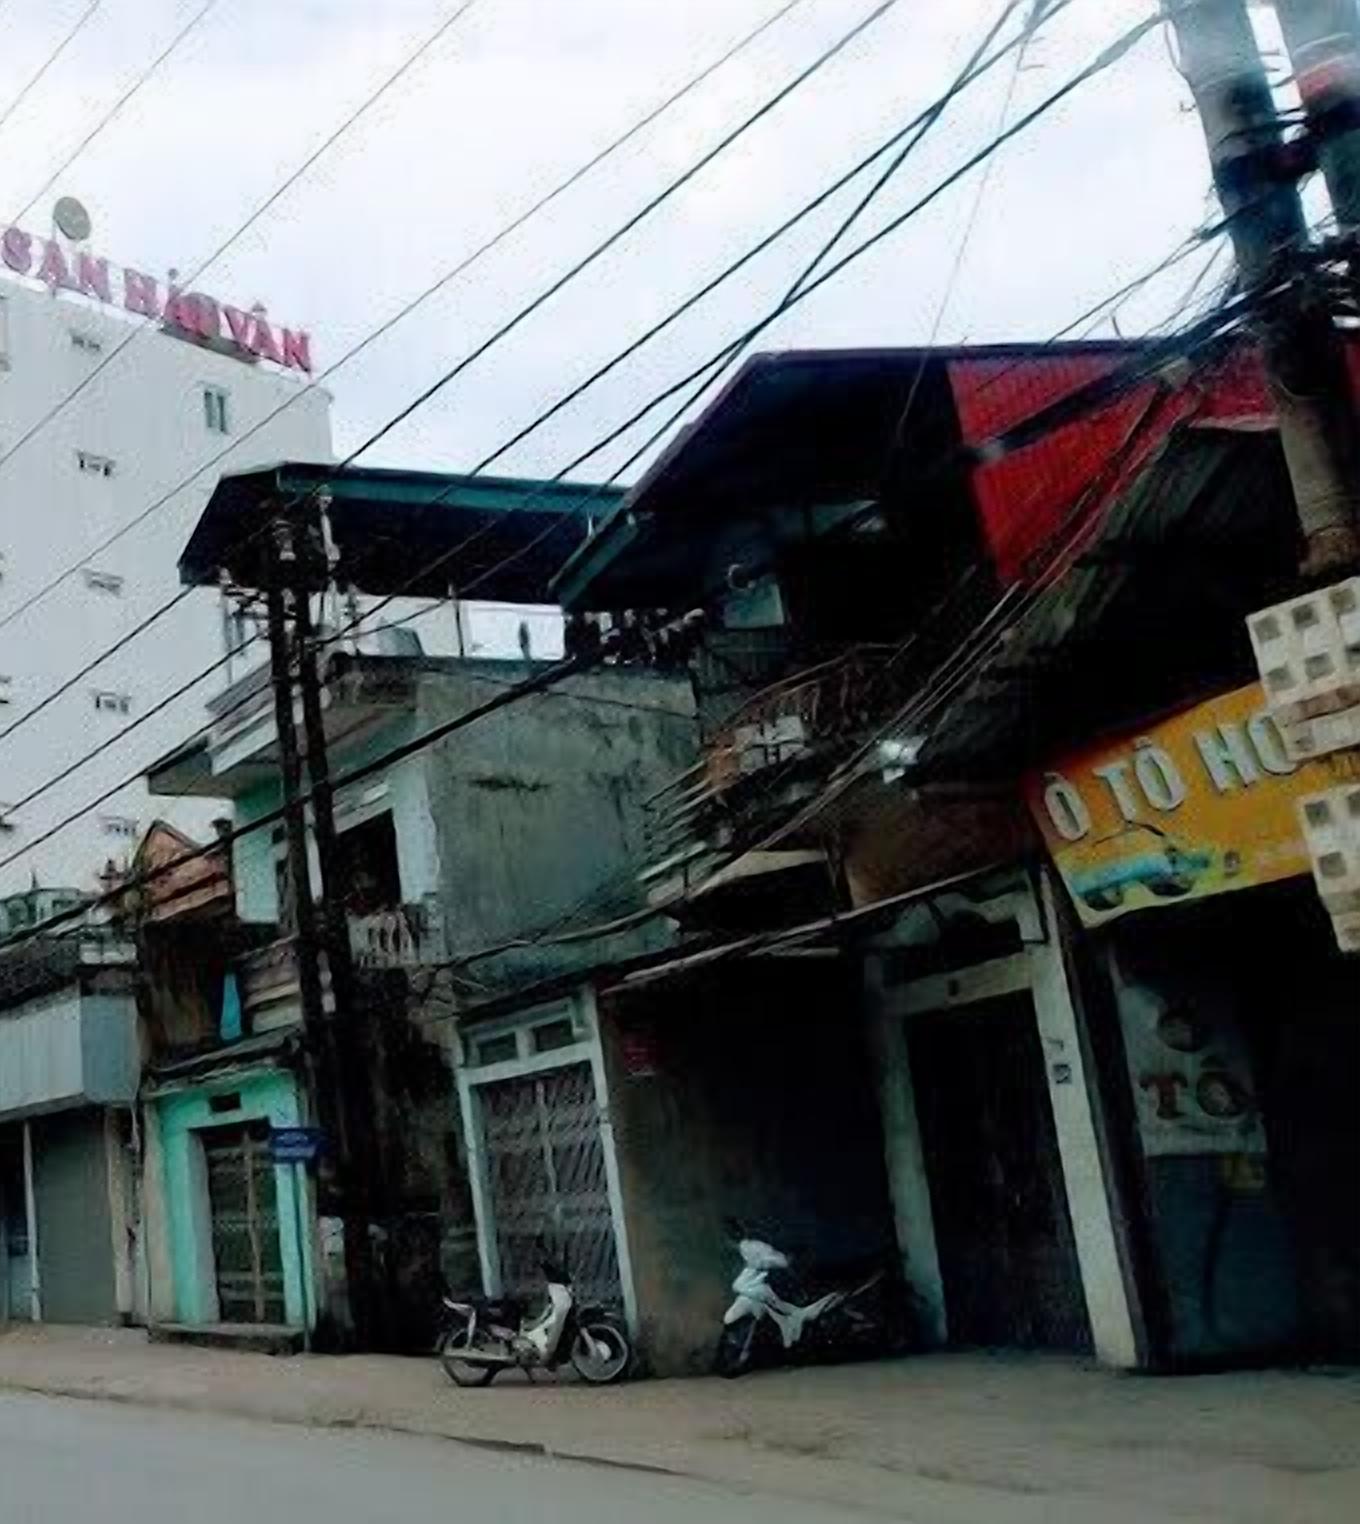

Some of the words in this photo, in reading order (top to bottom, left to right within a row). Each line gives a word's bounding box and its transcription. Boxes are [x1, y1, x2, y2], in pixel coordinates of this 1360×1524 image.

[222, 302, 312, 373] VÂN
[1044, 771, 1091, 842] Ô
[1093, 736, 1186, 823] TÔ
